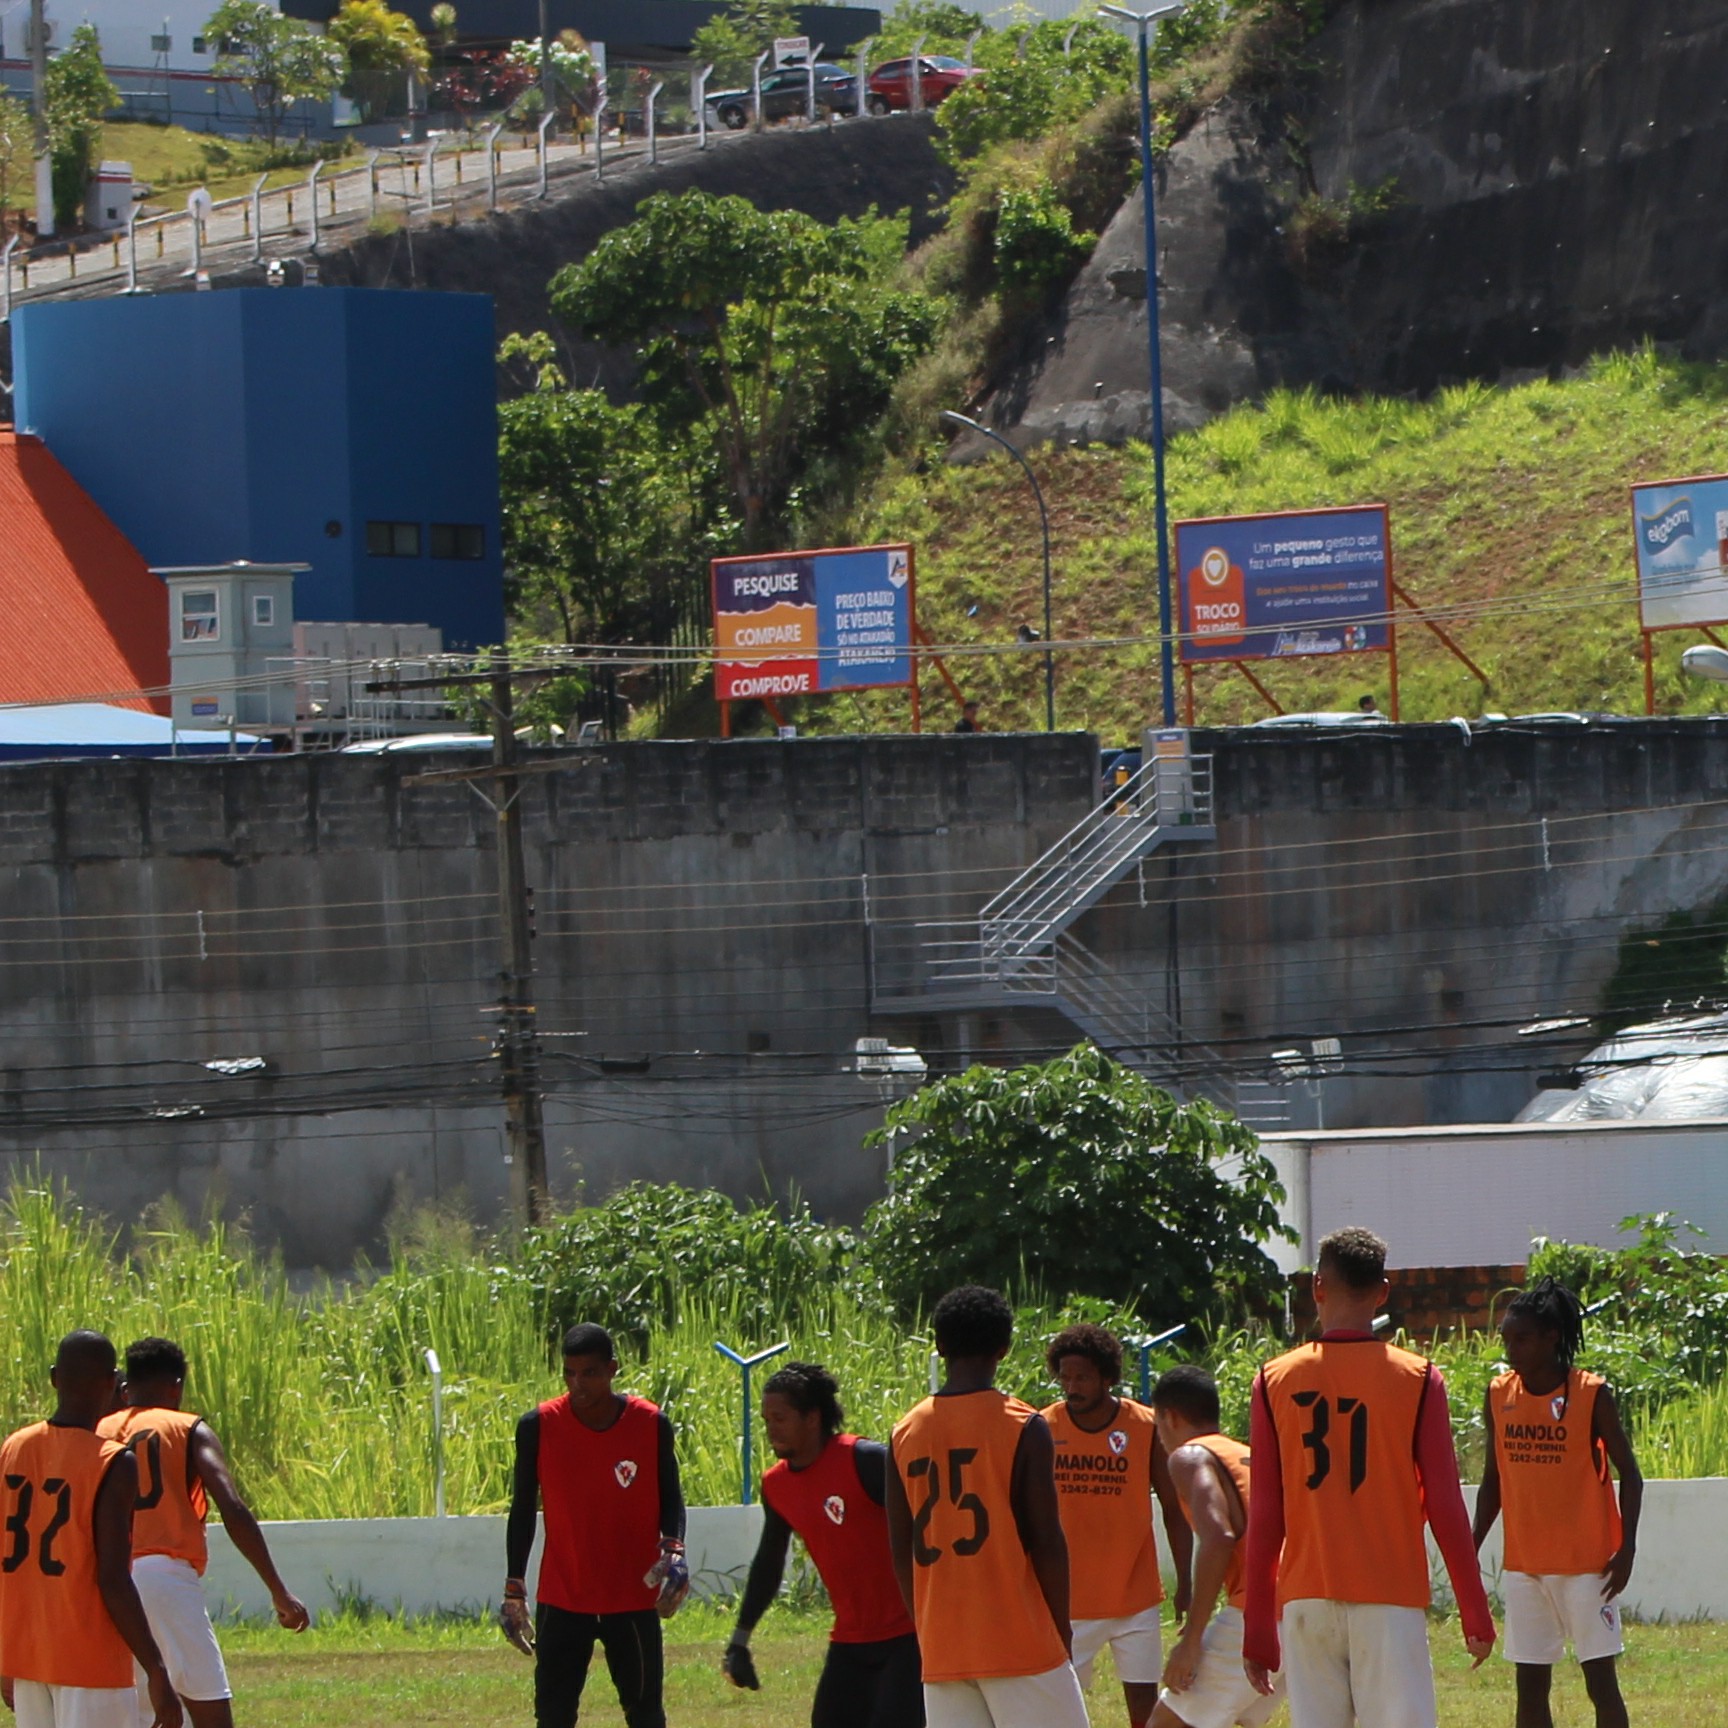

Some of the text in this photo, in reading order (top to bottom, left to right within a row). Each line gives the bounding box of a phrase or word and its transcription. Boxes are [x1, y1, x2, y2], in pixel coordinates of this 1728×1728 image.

[1253, 535, 1378, 555] Um pequeno gesto que
[1249, 550, 1384, 569] faz uma grande diferença
[734, 573, 799, 597] PESQUISE
[836, 590, 895, 612] PREÇO BAIXO
[836, 610, 895, 631] DE VERDADE
[1194, 603, 1240, 620] TROCO
[735, 624, 801, 646] COMPARE
[731, 673, 809, 697] COMPROVE
[1504, 1423, 1567, 1442] MANOLO
[1517, 1441, 1532, 1451] DO
[1534, 1443, 1568, 1452] PERNIL
[1055, 1453, 1129, 1474] MANOLO
[1509, 1453, 1562, 1464] 3242-8270
[1073, 1473, 1090, 1483] DO
[1092, 1474, 1127, 1484] PERNIL
[1061, 1484, 1122, 1496] 3242-8270
[907, 1447, 990, 1568] 25
[1, 1473, 71, 1578] 32
